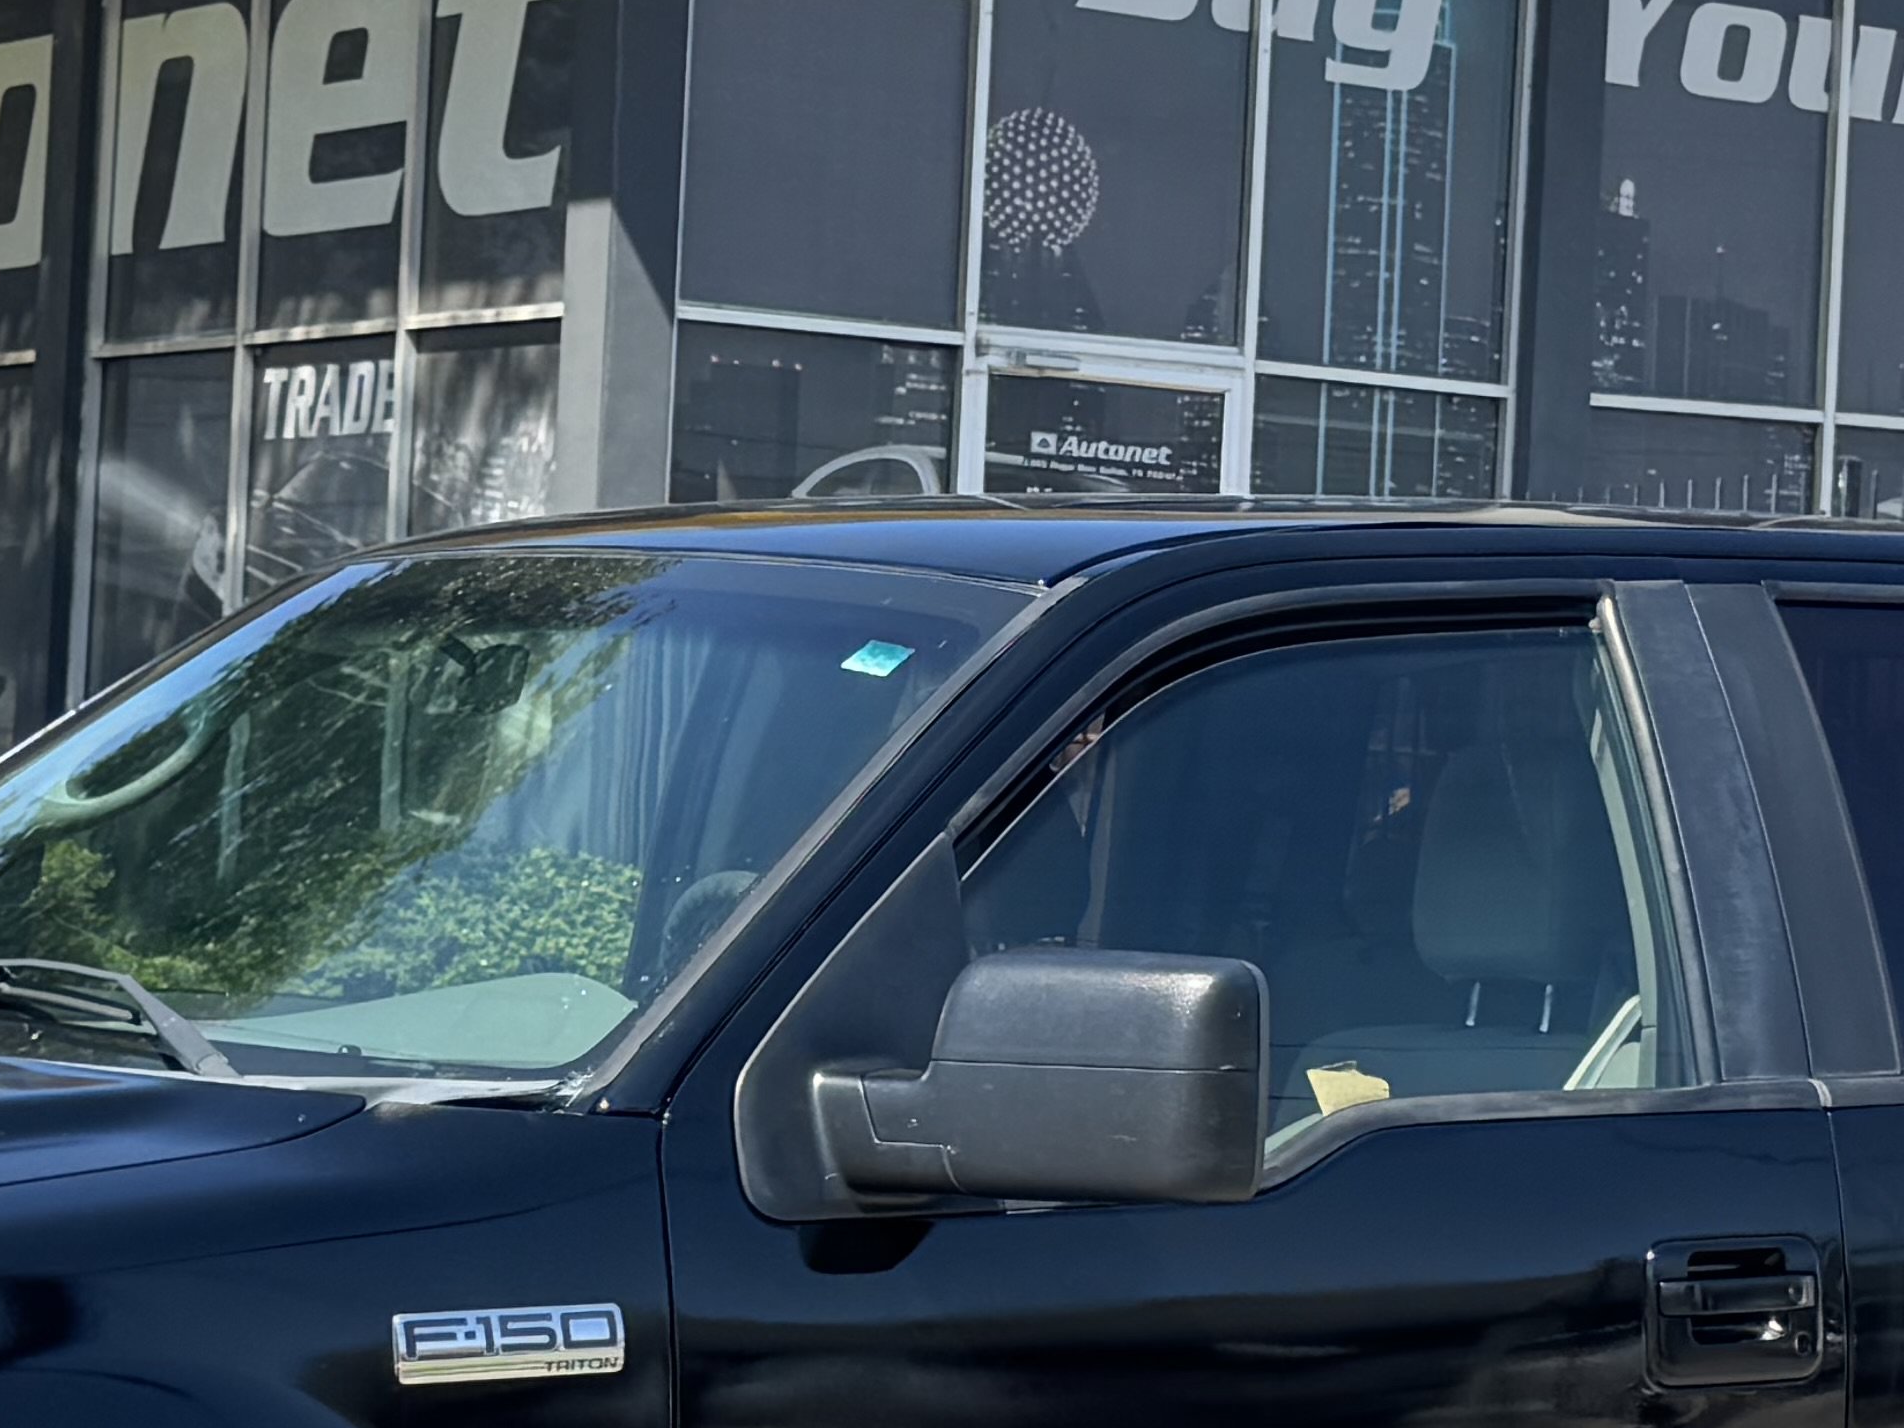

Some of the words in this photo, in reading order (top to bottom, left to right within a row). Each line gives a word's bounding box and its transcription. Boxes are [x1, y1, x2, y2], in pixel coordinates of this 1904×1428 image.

[262, 359, 396, 441] TRADE
[1058, 435, 1173, 466] Autonet
[544, 1355, 620, 1373] TRITON
